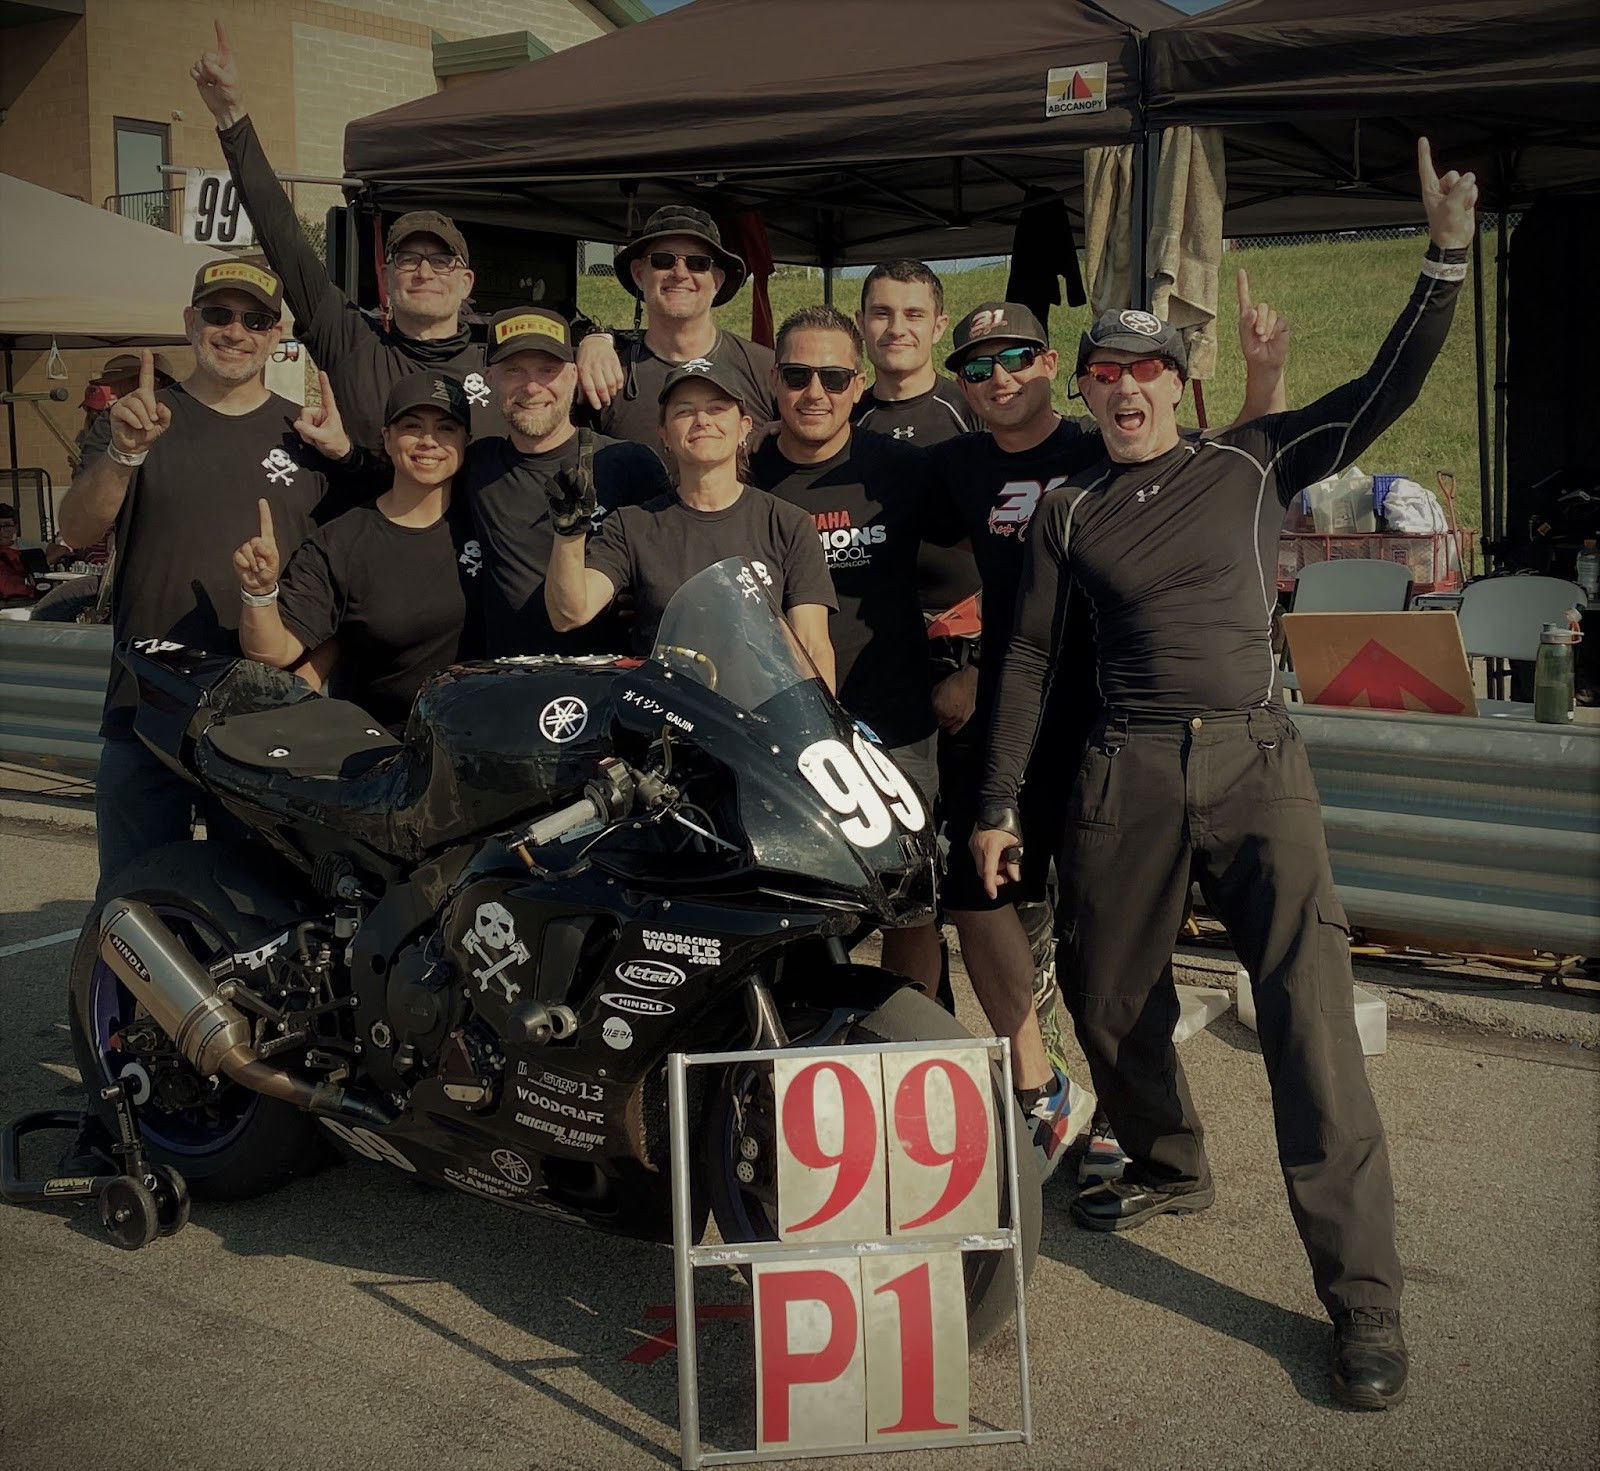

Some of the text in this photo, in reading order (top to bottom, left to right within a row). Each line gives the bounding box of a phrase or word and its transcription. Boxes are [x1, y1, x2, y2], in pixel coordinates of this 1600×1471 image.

[1048, 99, 1103, 113] ABCCANOPY
[195, 177, 240, 242] 99
[996, 474, 1069, 522] 3
[810, 510, 851, 530] AHA
[818, 524, 887, 550] IONS
[622, 689, 695, 733] ガイジン GAIJIN
[797, 731, 926, 848] 99
[642, 929, 721, 947] ROADRACING
[643, 938, 721, 958] WORLD
[112, 937, 149, 979] HINDLE
[618, 998, 663, 1012] HINDLE
[516, 1085, 604, 1124] WOODCRAFT
[318, 1116, 418, 1173] 99
[515, 1112, 606, 1146] CHICKEN HAWK
[553, 1135, 594, 1152] Racing
[782, 1058, 989, 1234] 99
[758, 1262, 958, 1443] P1
